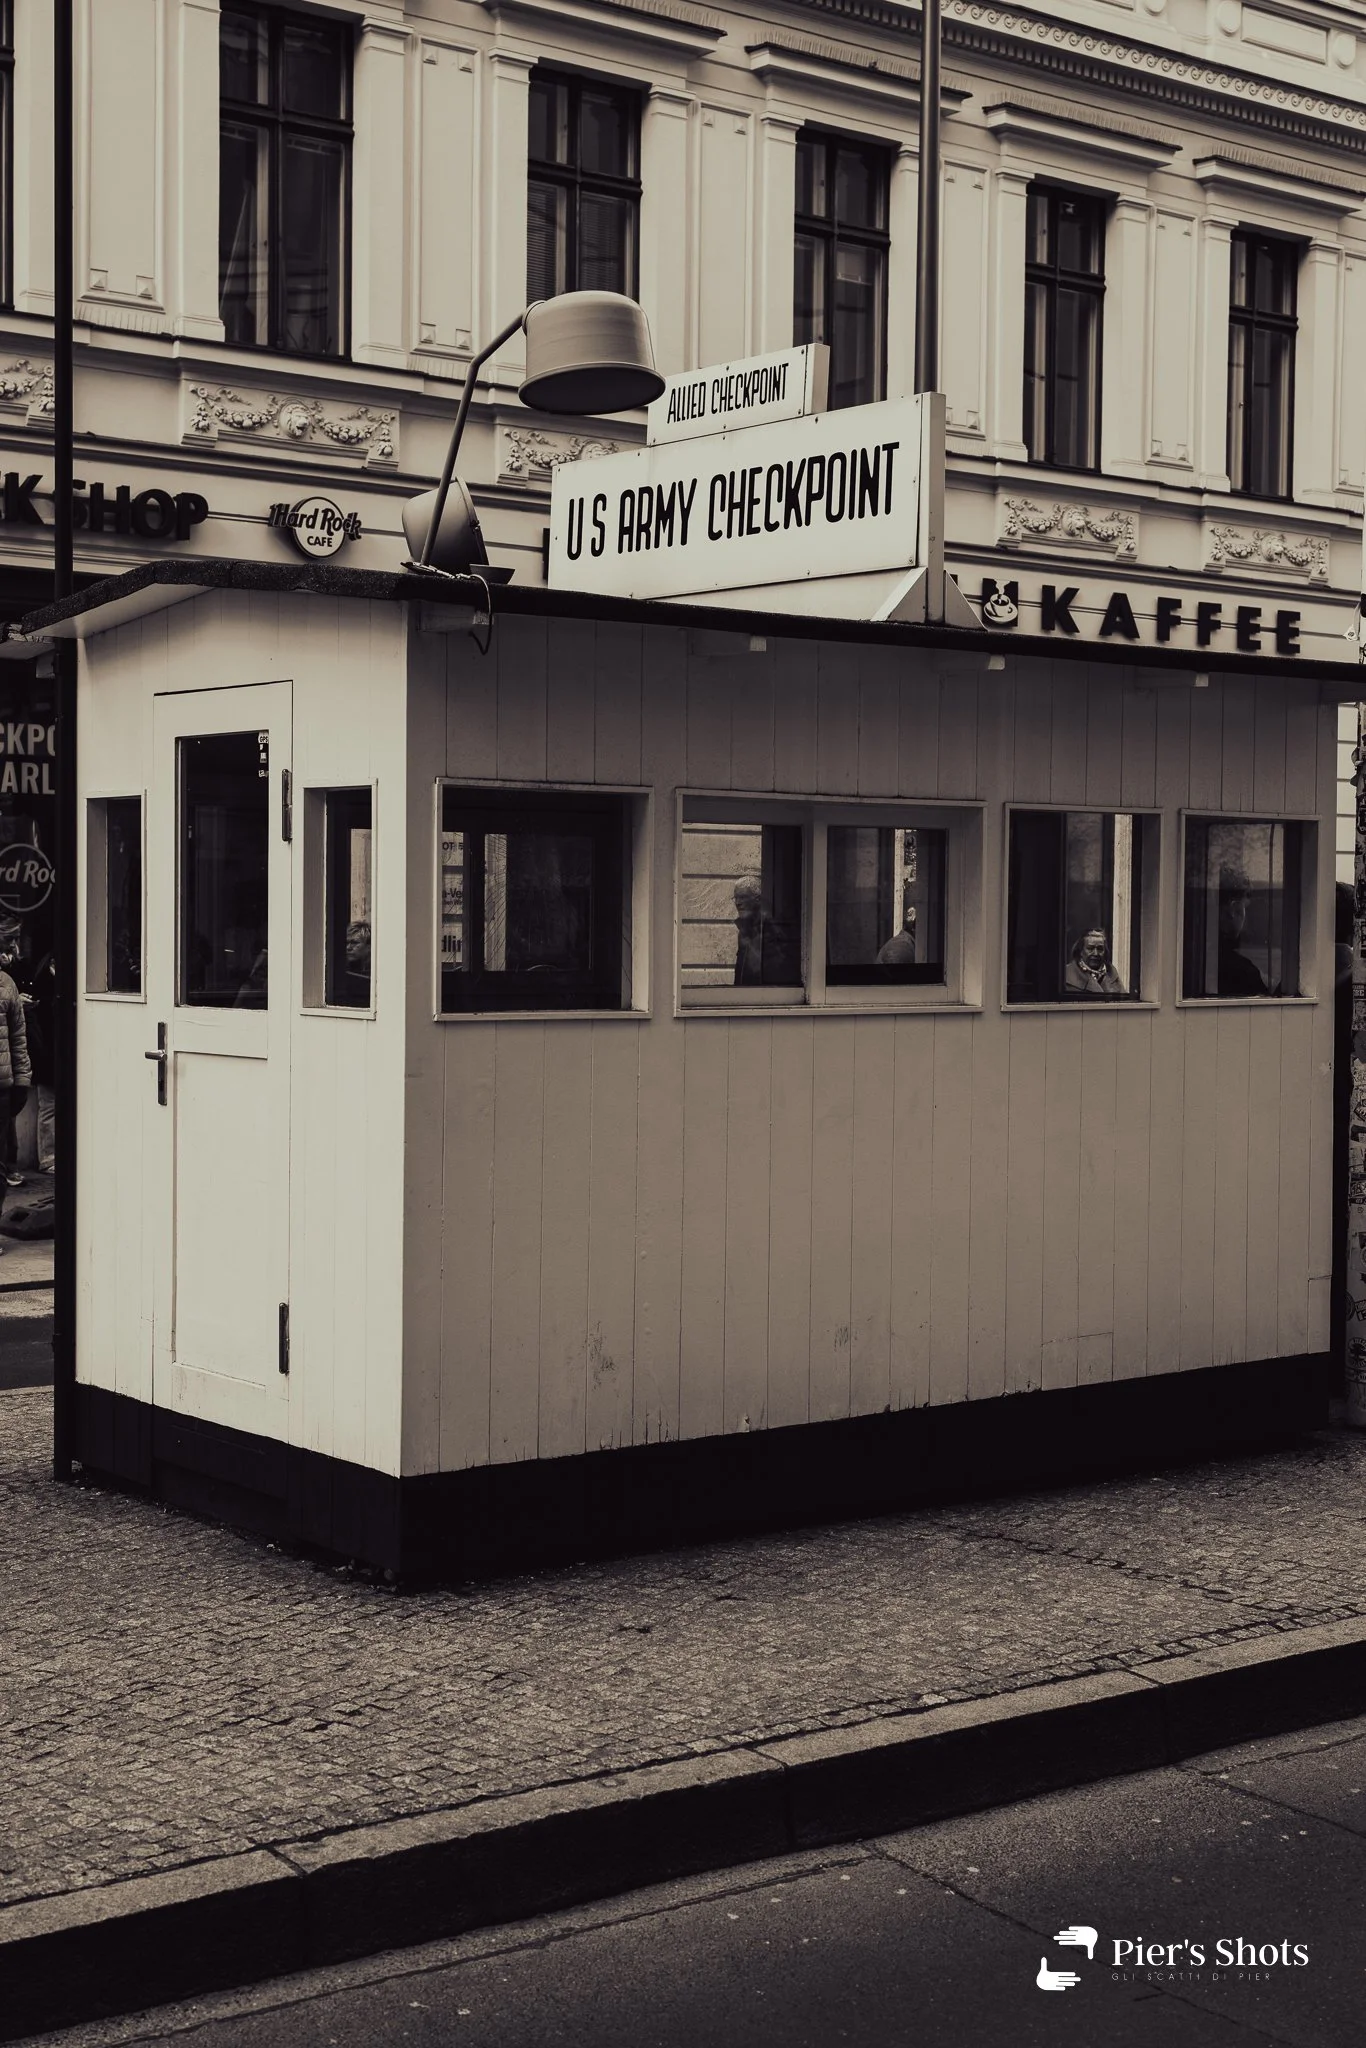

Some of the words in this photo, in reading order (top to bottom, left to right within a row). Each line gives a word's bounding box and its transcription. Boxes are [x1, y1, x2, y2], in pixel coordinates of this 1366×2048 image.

[667, 381, 706, 424] ALLIED
[711, 362, 790, 415] CHECKPOINT
[0, 471, 44, 525] K
[269, 503, 320, 529] Hard
[320, 508, 362, 541] Rock
[567, 498, 584, 561] U
[591, 493, 607, 557] S
[617, 477, 698, 554] ARMY
[708, 441, 900, 541] CHECKPOINT
[307, 535, 333, 547] CAFE
[1041, 584, 1301, 655] KAFFEE
